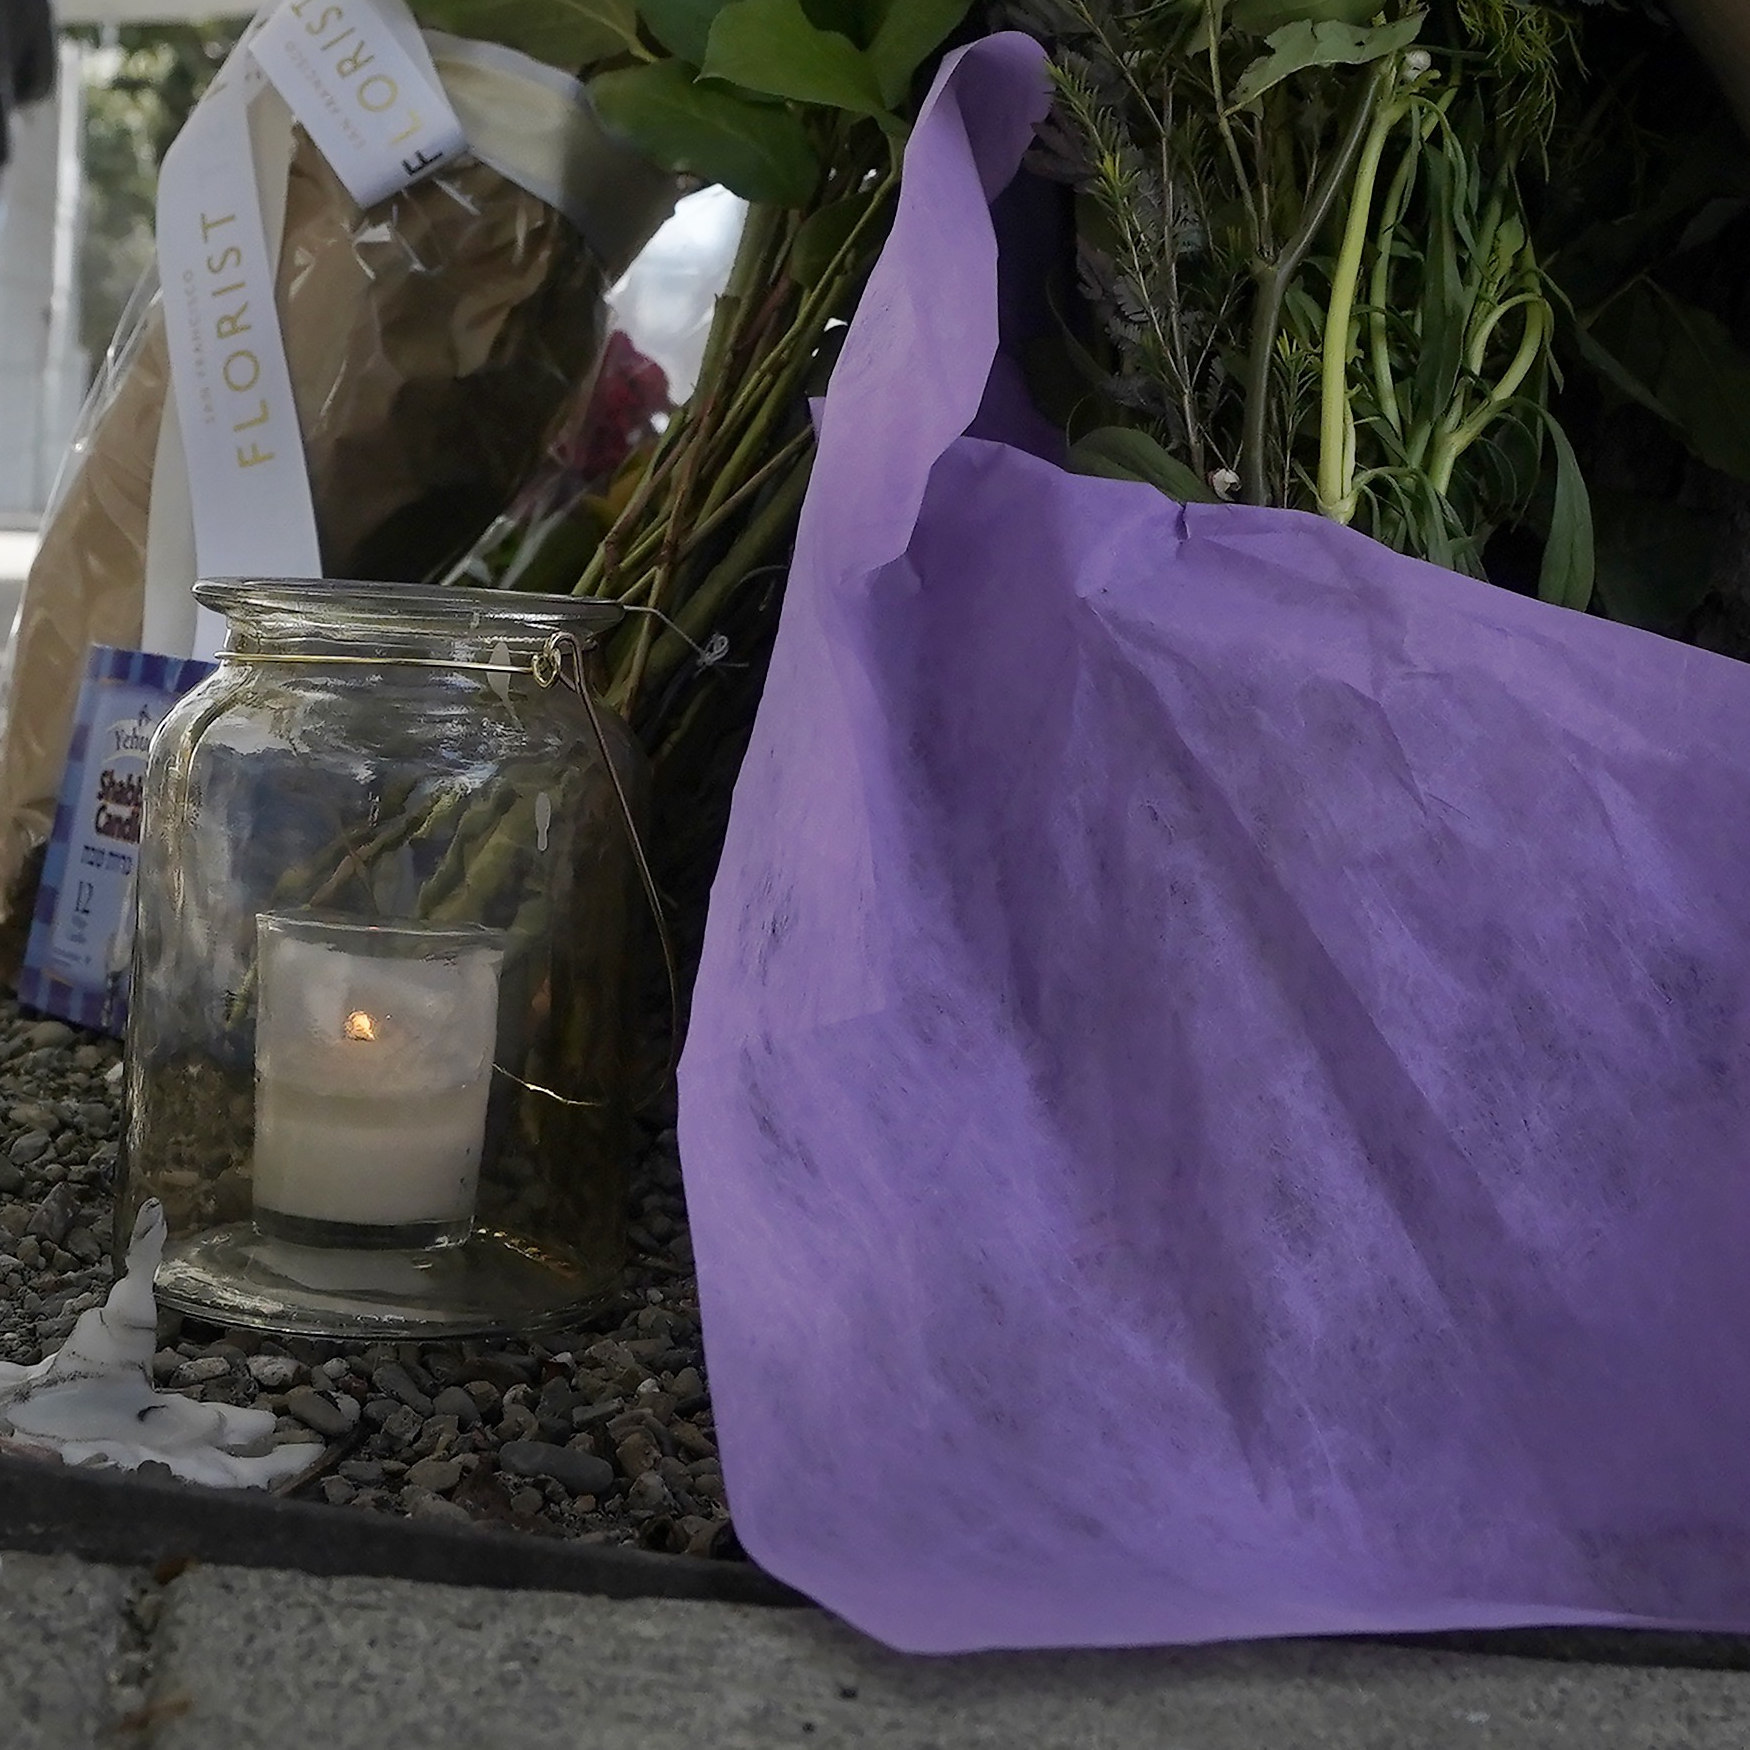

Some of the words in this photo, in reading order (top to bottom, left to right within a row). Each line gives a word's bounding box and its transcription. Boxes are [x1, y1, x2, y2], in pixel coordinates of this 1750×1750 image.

[181, 269, 206, 378] FRANCISCO
[200, 213, 276, 468] FLORIST
[199, 386, 215, 424] SAN
[115, 727, 149, 751] Yehu
[75, 881, 94, 914] 12
